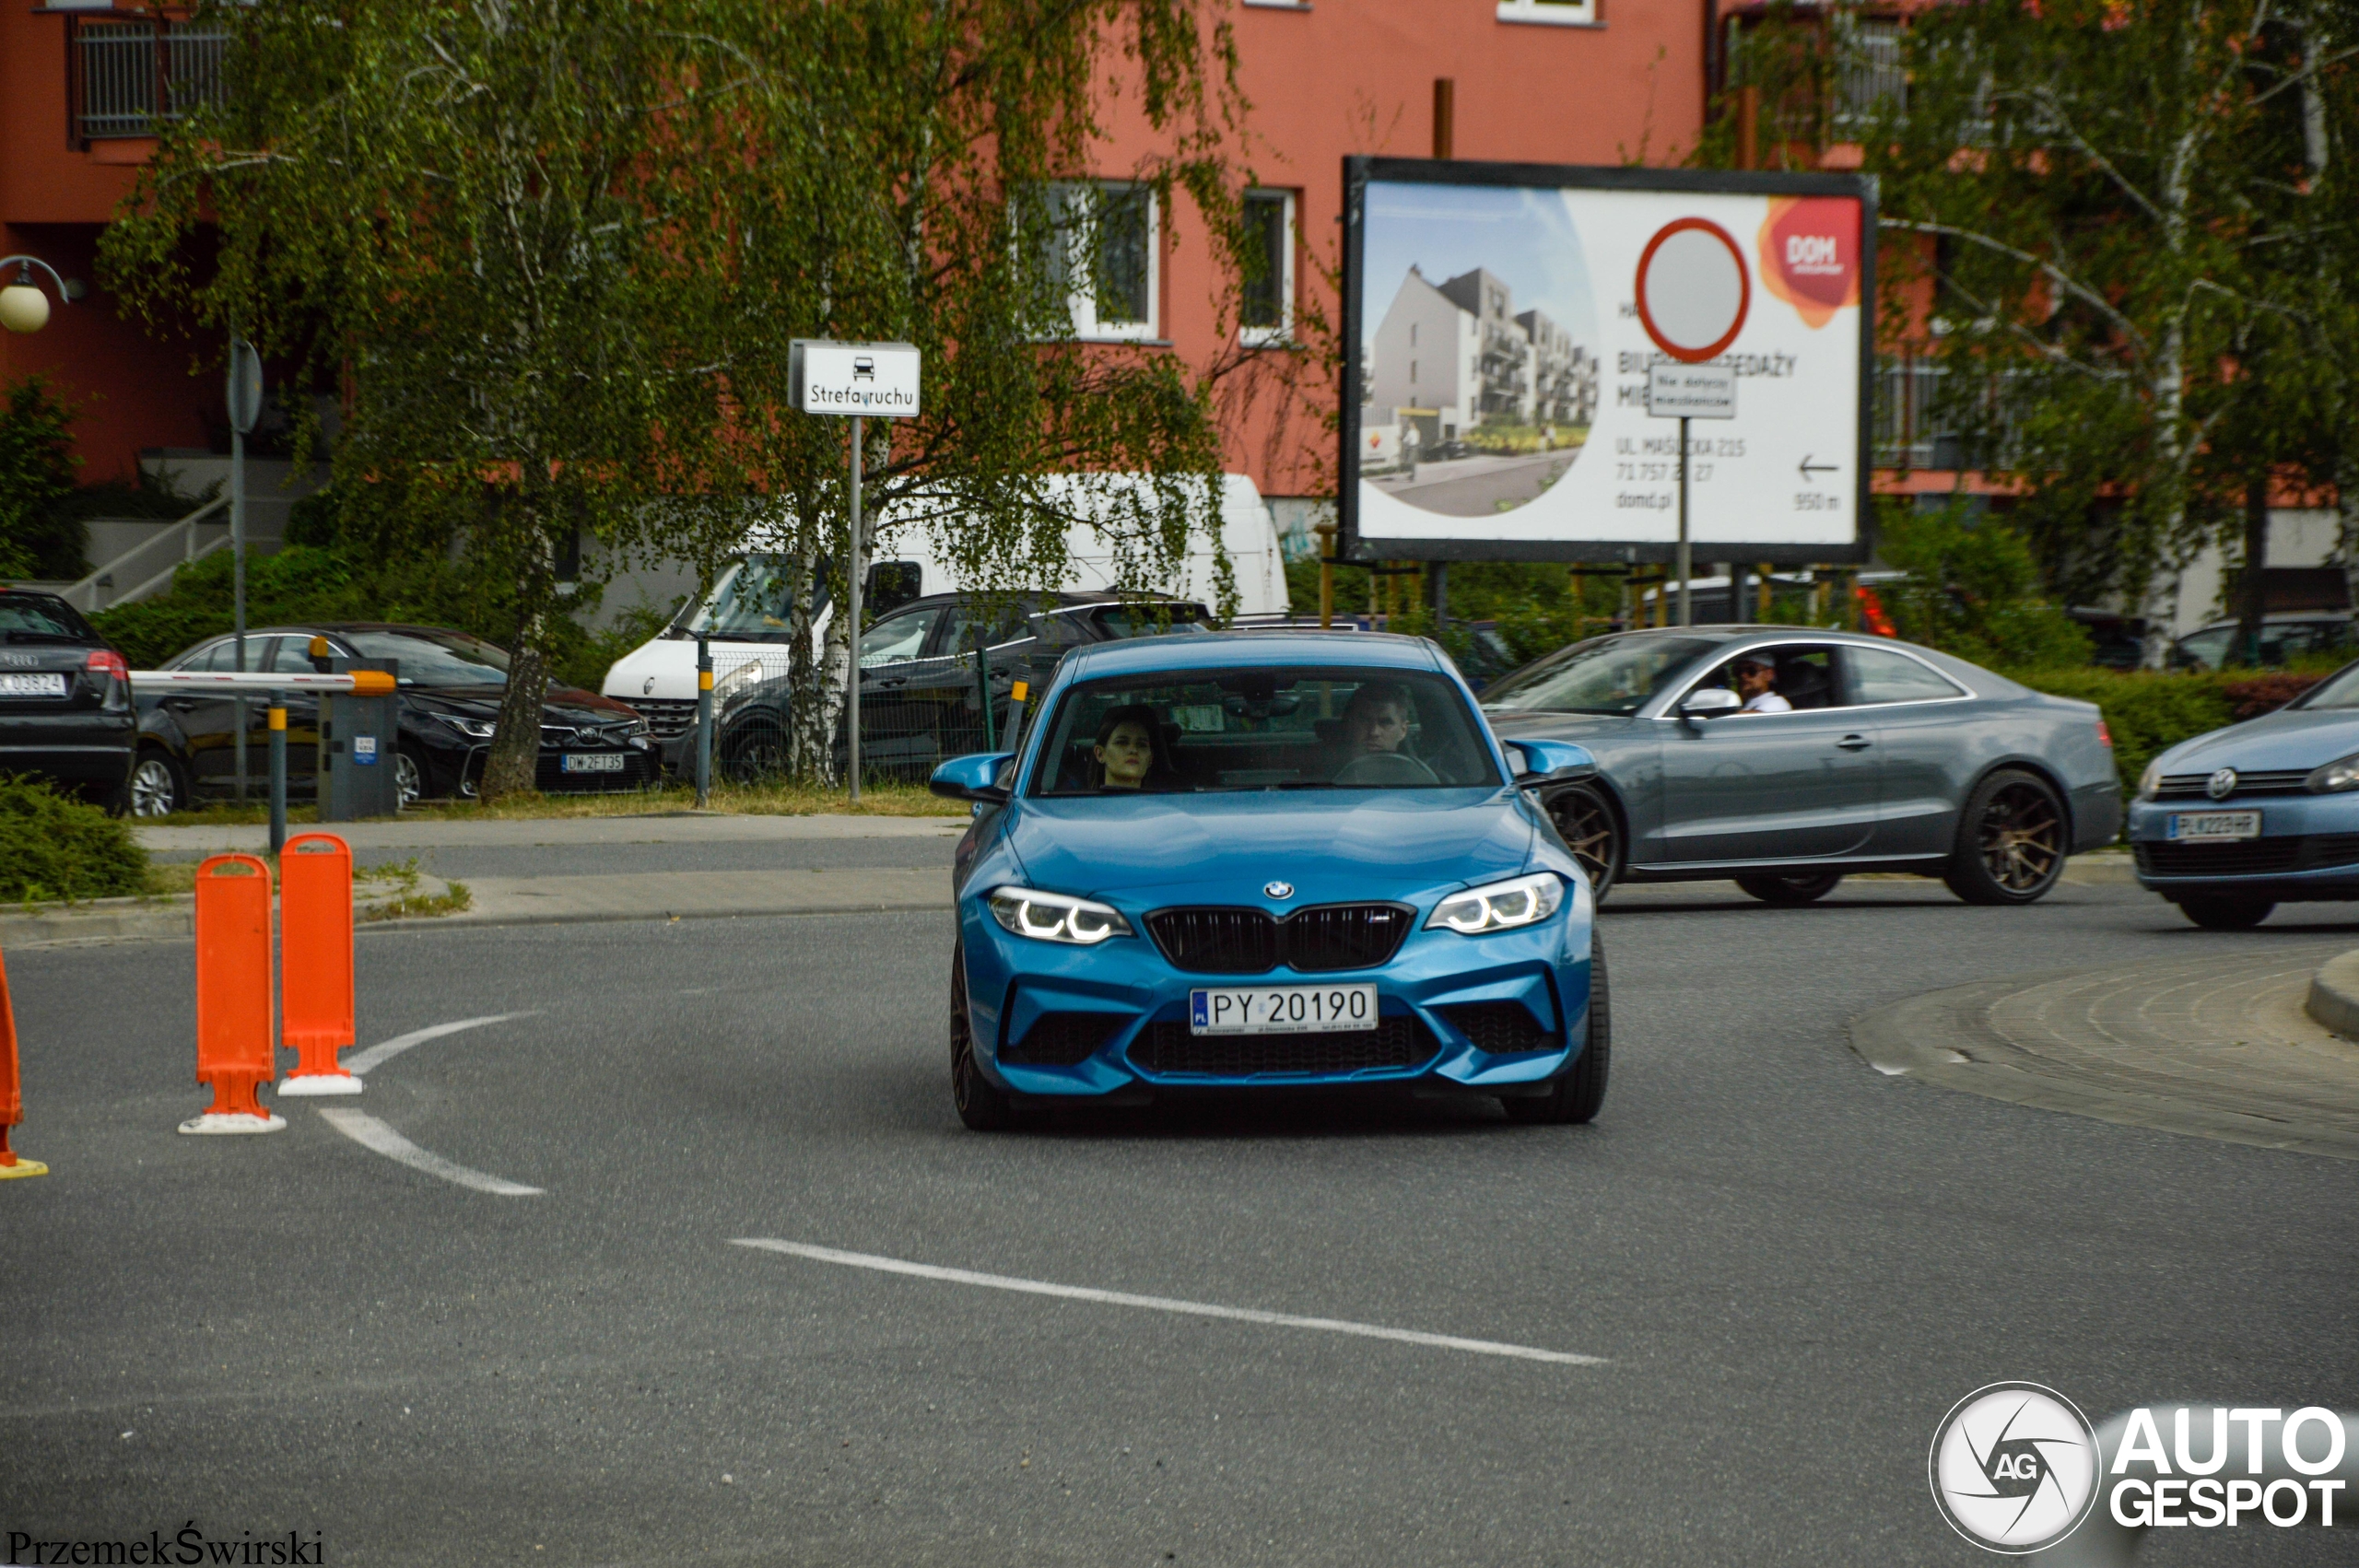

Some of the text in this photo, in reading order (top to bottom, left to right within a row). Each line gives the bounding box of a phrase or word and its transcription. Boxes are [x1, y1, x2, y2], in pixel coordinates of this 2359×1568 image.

[1787, 234, 1837, 264] DOM
[1618, 348, 1796, 378] BIU EDAŻY
[811, 384, 913, 405] Strefa ruchu
[1642, 433, 1714, 456] MAŚLCKA
[1717, 438, 1746, 457] 215
[1616, 462, 1635, 481] 71
[1639, 462, 1668, 481] 757
[1694, 463, 1714, 482] 27
[1615, 490, 1674, 512] domd.pl
[1794, 492, 1841, 511] 950 m
[587, 755, 621, 769] 2FT35
[1214, 990, 1367, 1024] PY 20190
[1195, 1013, 1206, 1024] PL
